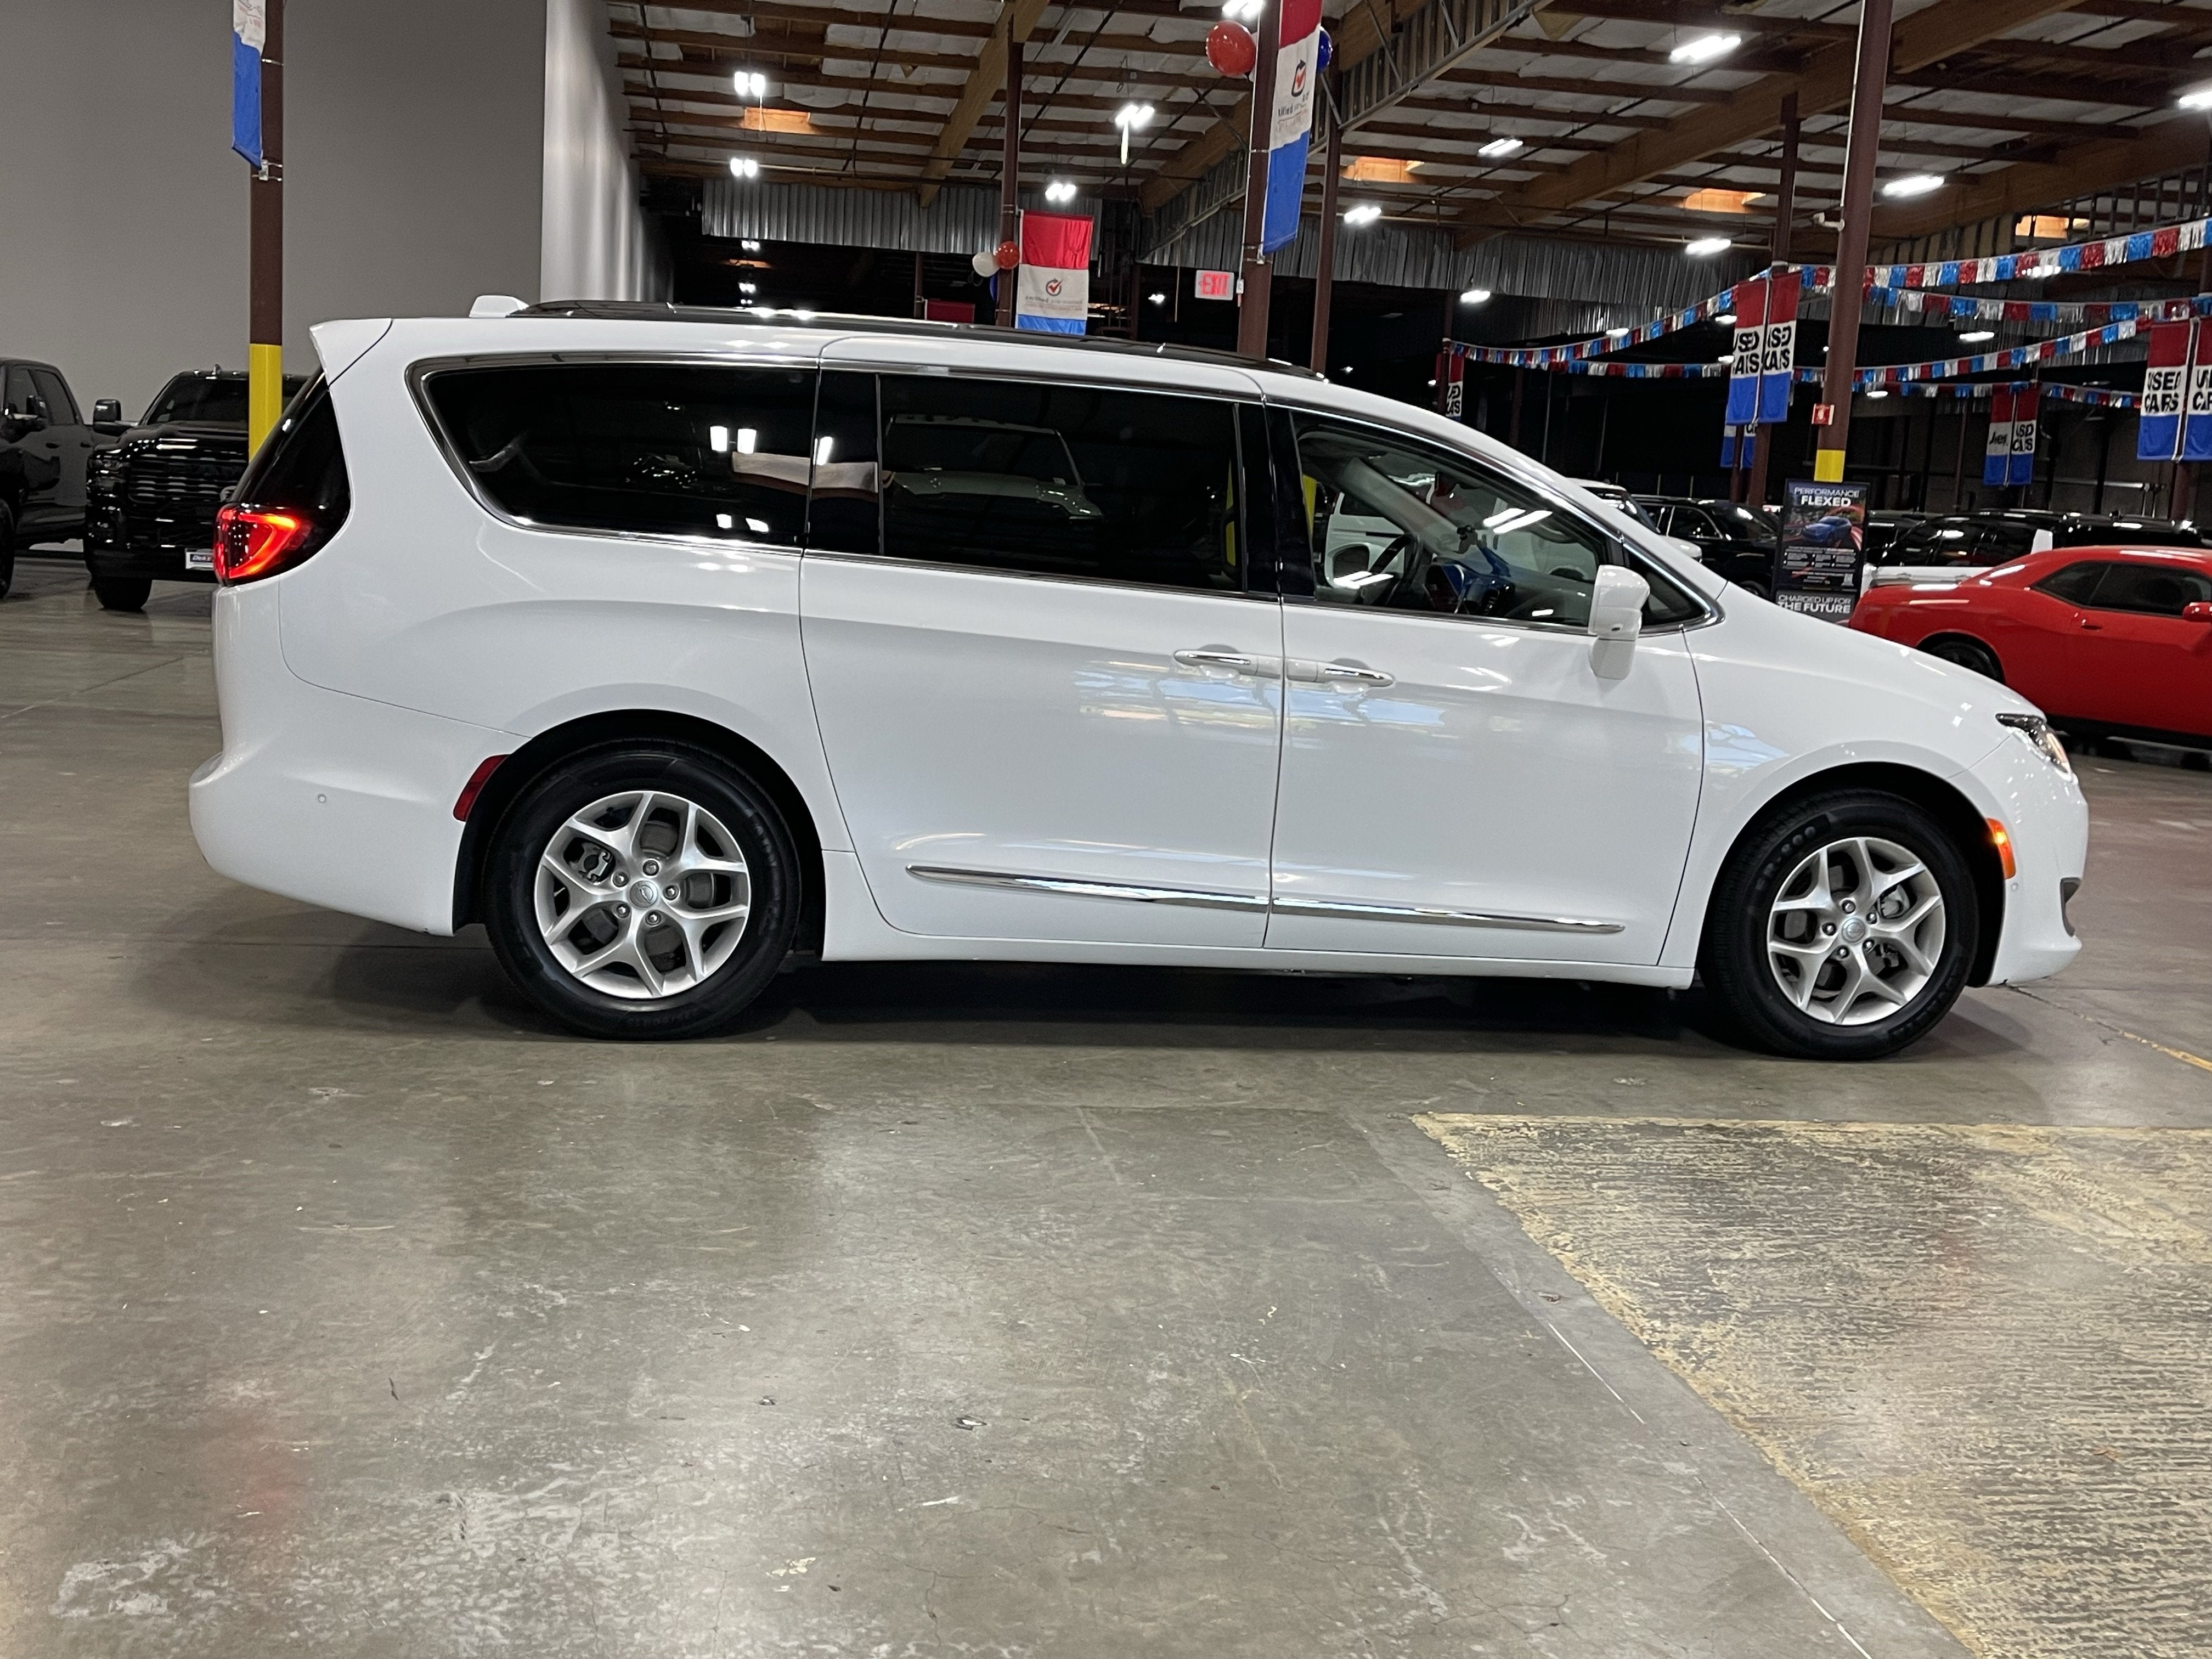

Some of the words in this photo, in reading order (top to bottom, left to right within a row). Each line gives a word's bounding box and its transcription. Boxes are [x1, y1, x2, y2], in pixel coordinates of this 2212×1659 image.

[1201, 272, 1229, 296] EXIT
[2145, 393, 2179, 413] CARS
[1794, 487, 1860, 498] PERFORMANCE
[1801, 495, 1852, 507] FLEXED
[1778, 594, 1821, 603] CHARGED
[1778, 601, 1802, 611] THE
[1803, 602, 1851, 614] FUTURE
